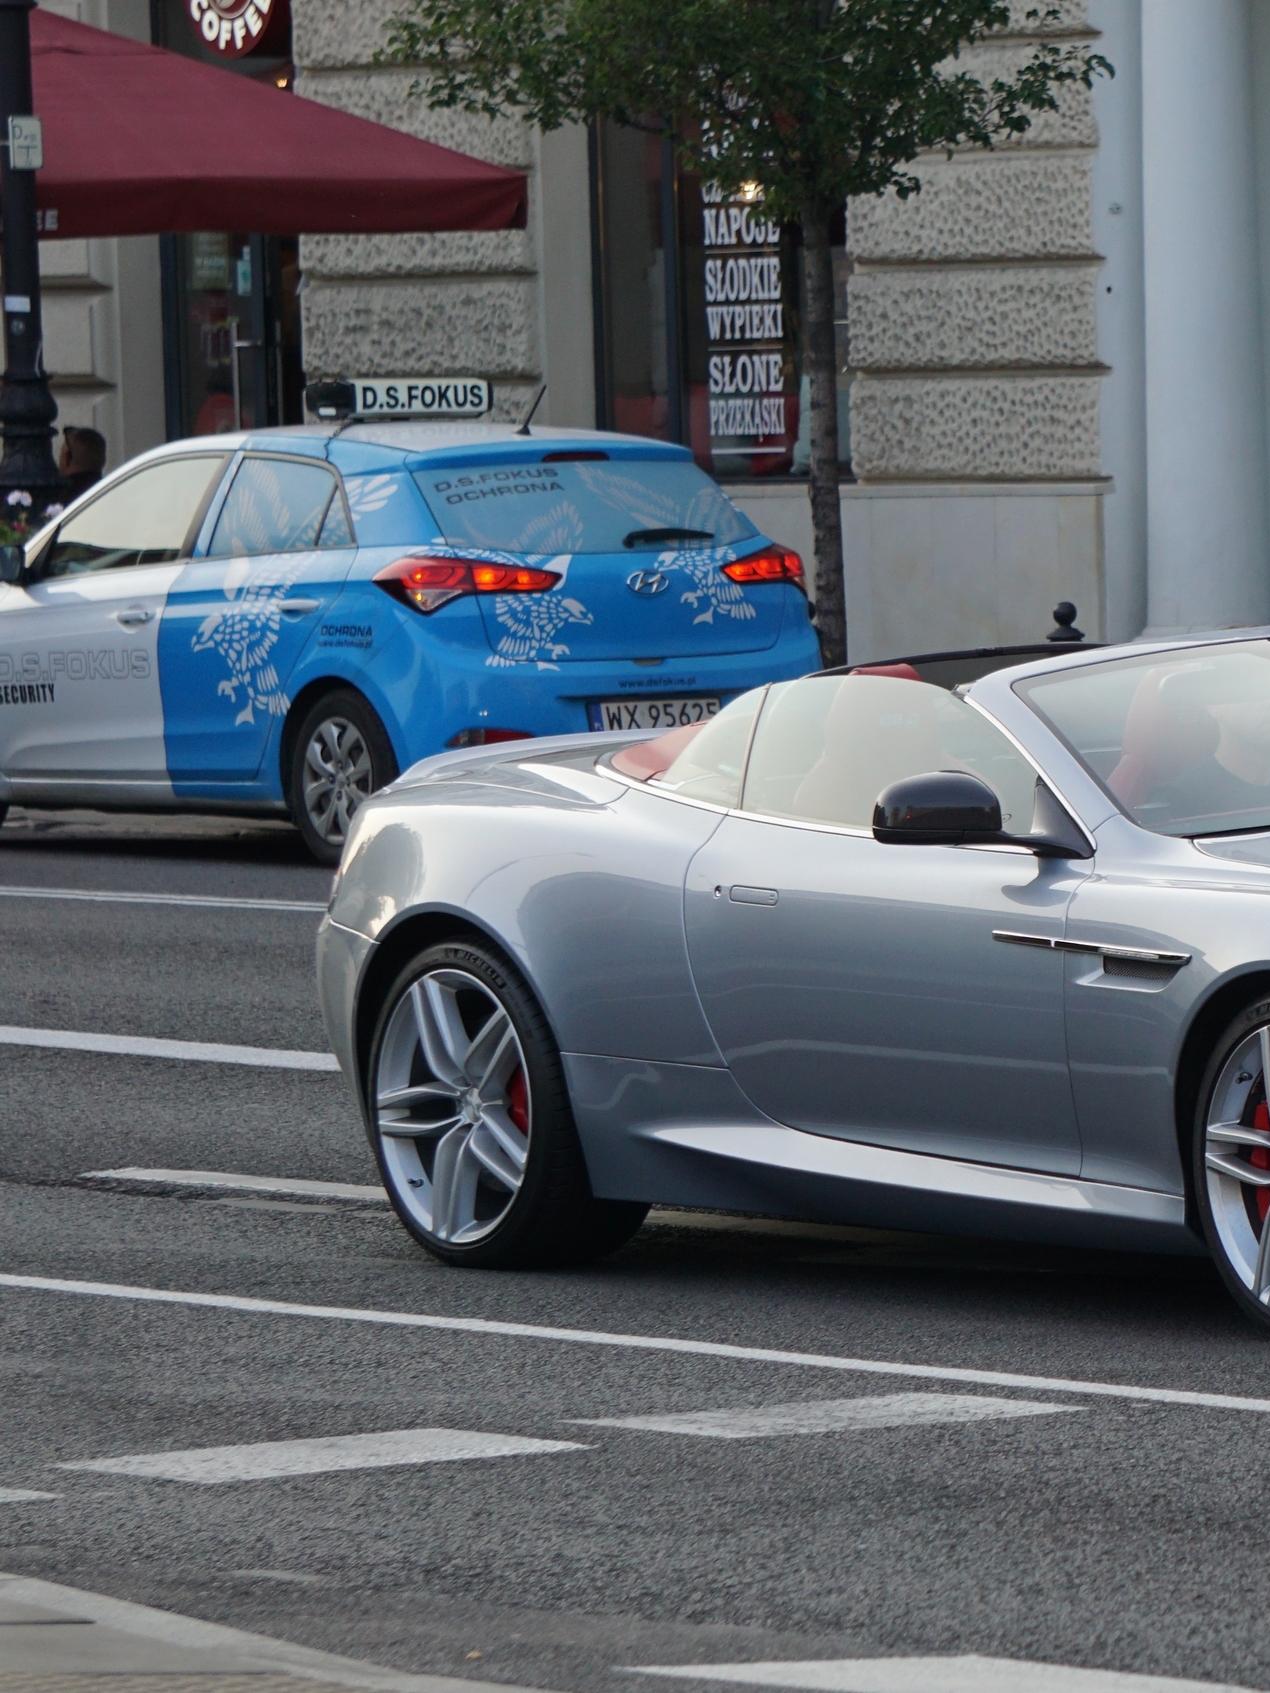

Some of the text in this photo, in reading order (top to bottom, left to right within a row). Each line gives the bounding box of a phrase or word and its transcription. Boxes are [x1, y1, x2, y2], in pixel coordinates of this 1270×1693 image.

[703, 207, 781, 246] NAPOJE
[705, 257, 781, 303] SŁODKIE
[706, 303, 784, 341] WYPIEKI
[709, 353, 784, 394] SŁONE
[362, 385, 484, 410] D.S.FOKUS
[710, 398, 786, 443] PRZEKĄSKI
[434, 468, 559, 493] D.S.FOKUS
[446, 482, 565, 505] OCHRONA
[321, 625, 373, 637] OCHRONA
[0, 649, 151, 682] D.S.FOKUS
[606, 702, 717, 730] WX 95625
